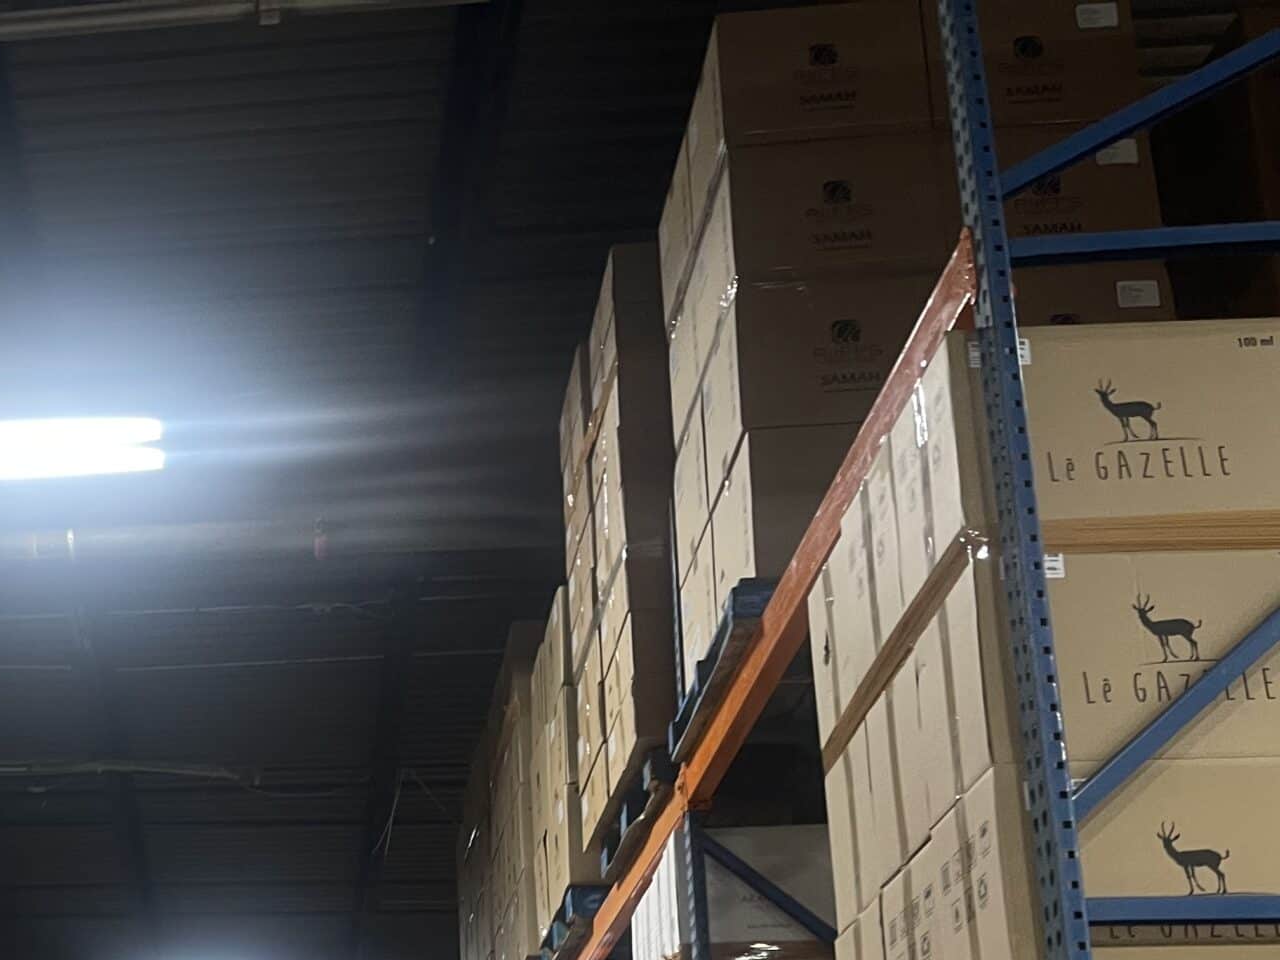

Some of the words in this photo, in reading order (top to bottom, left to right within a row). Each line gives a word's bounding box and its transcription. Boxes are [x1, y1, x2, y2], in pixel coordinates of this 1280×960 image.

[1237, 337, 1257, 349] 100
[1260, 336, 1274, 347] ml
[1094, 446, 1232, 481] GAZELLE
